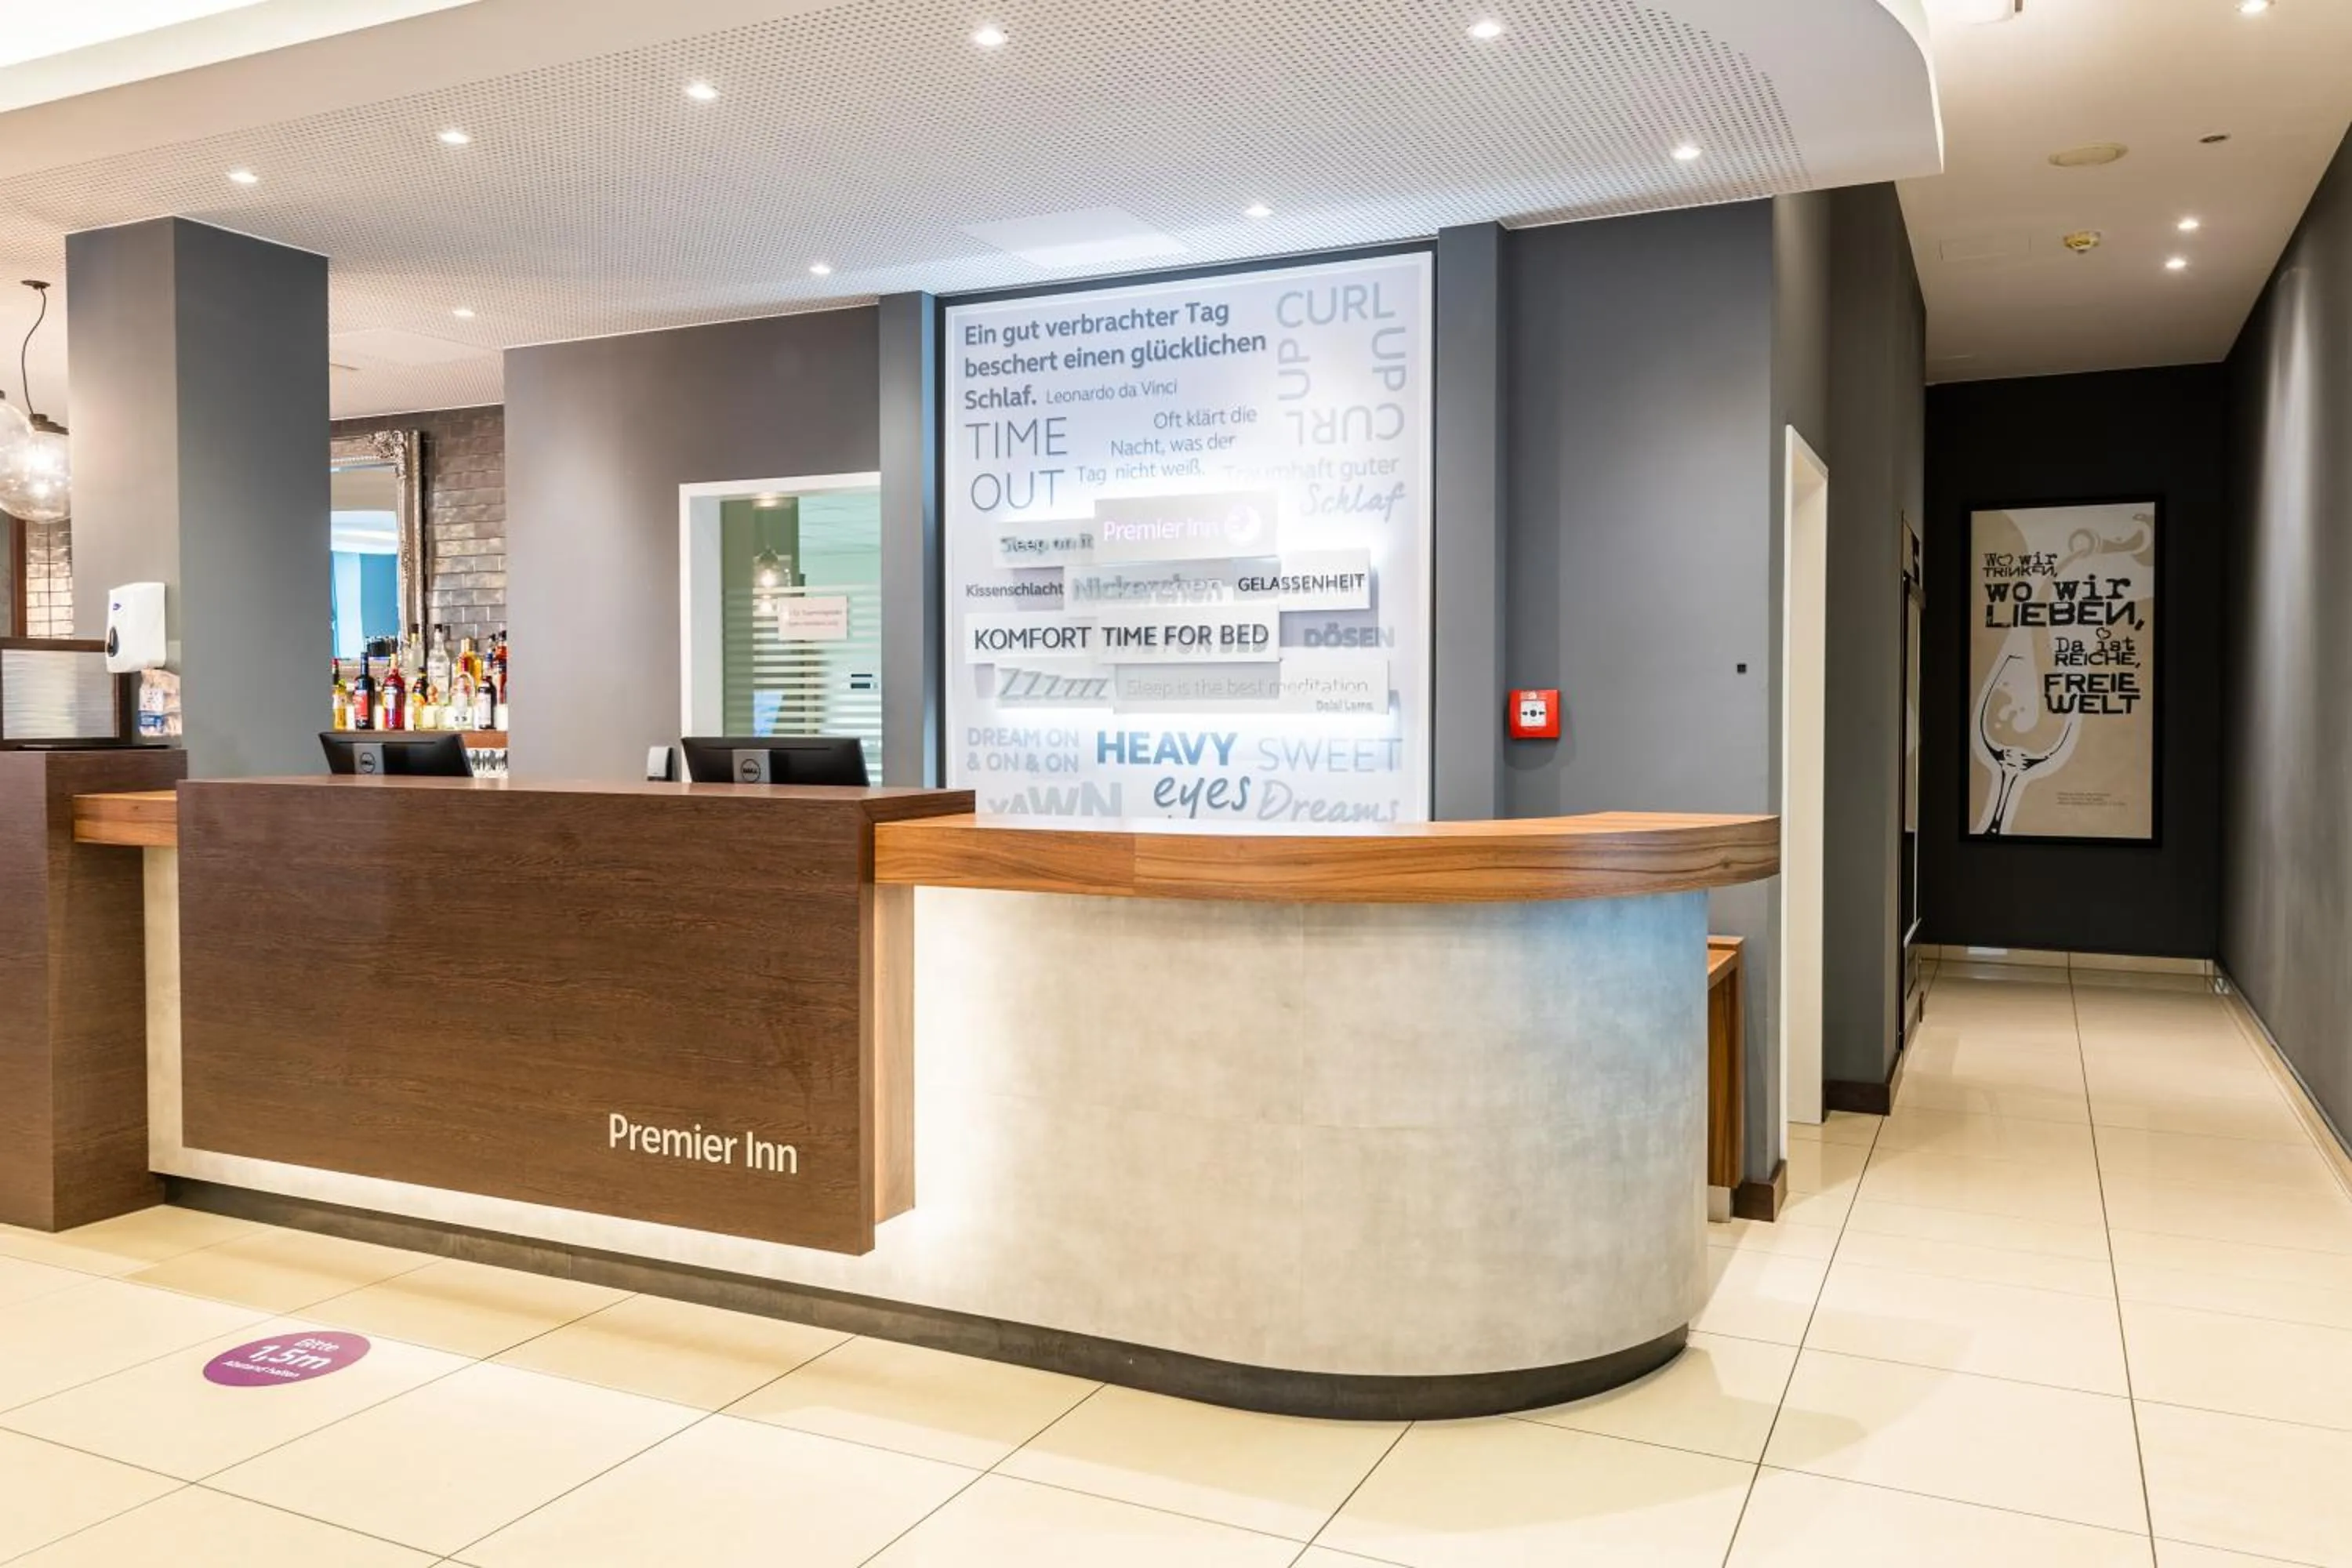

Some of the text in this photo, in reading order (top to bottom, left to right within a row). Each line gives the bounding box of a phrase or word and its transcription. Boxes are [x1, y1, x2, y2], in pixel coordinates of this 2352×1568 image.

[1276, 282, 1396, 328] CURL
[965, 303, 1229, 348] Ein gut verbrachter Tag
[965, 333, 1266, 378] beschert einen glücklichen
[1278, 338, 1311, 401] UP
[1372, 326, 1406, 391] UP
[965, 379, 1178, 410] Schlaf. Leonardo da Vinci
[1153, 405, 1258, 430] Oft klärt die
[1285, 402, 1405, 447] CURL
[965, 417, 1068, 460] TIME
[1111, 433, 1236, 458] Nacht, was der
[1076, 457, 1206, 486] Tag nicht weiß.
[1340, 456, 1400, 483] guter
[971, 470, 1065, 512] OUT
[1298, 481, 1406, 524] Schlaf
[1103, 517, 1221, 542] Premier Inn
[965, 582, 1064, 597] Kissenschlacht
[1238, 573, 1365, 592] GELASSENHEIT
[2053, 574, 2132, 600] wir
[1985, 601, 2145, 630] LIEBEN,
[975, 627, 1092, 649] KOMFORT
[1101, 624, 1269, 648] TIME FOR BED
[1304, 622, 1395, 648] DÖSEN
[2055, 627, 2136, 653] Da ist
[2055, 651, 2141, 668] REICHE,
[1127, 678, 1171, 700] Sleep
[1196, 677, 1222, 695] the
[1227, 677, 1263, 695] best
[1269, 677, 1368, 695] meditation
[2044, 672, 2140, 694] FREIE
[2044, 693, 2141, 714] WELT
[967, 728, 1080, 748] DREAM ON
[1097, 731, 1239, 765] HEAVY
[966, 752, 1079, 773] & ON & ON
[1256, 737, 1403, 772] SWEET
[1153, 775, 1251, 819] eyes
[1256, 779, 1400, 822] Dreams
[609, 1112, 797, 1174] Premier Inn
